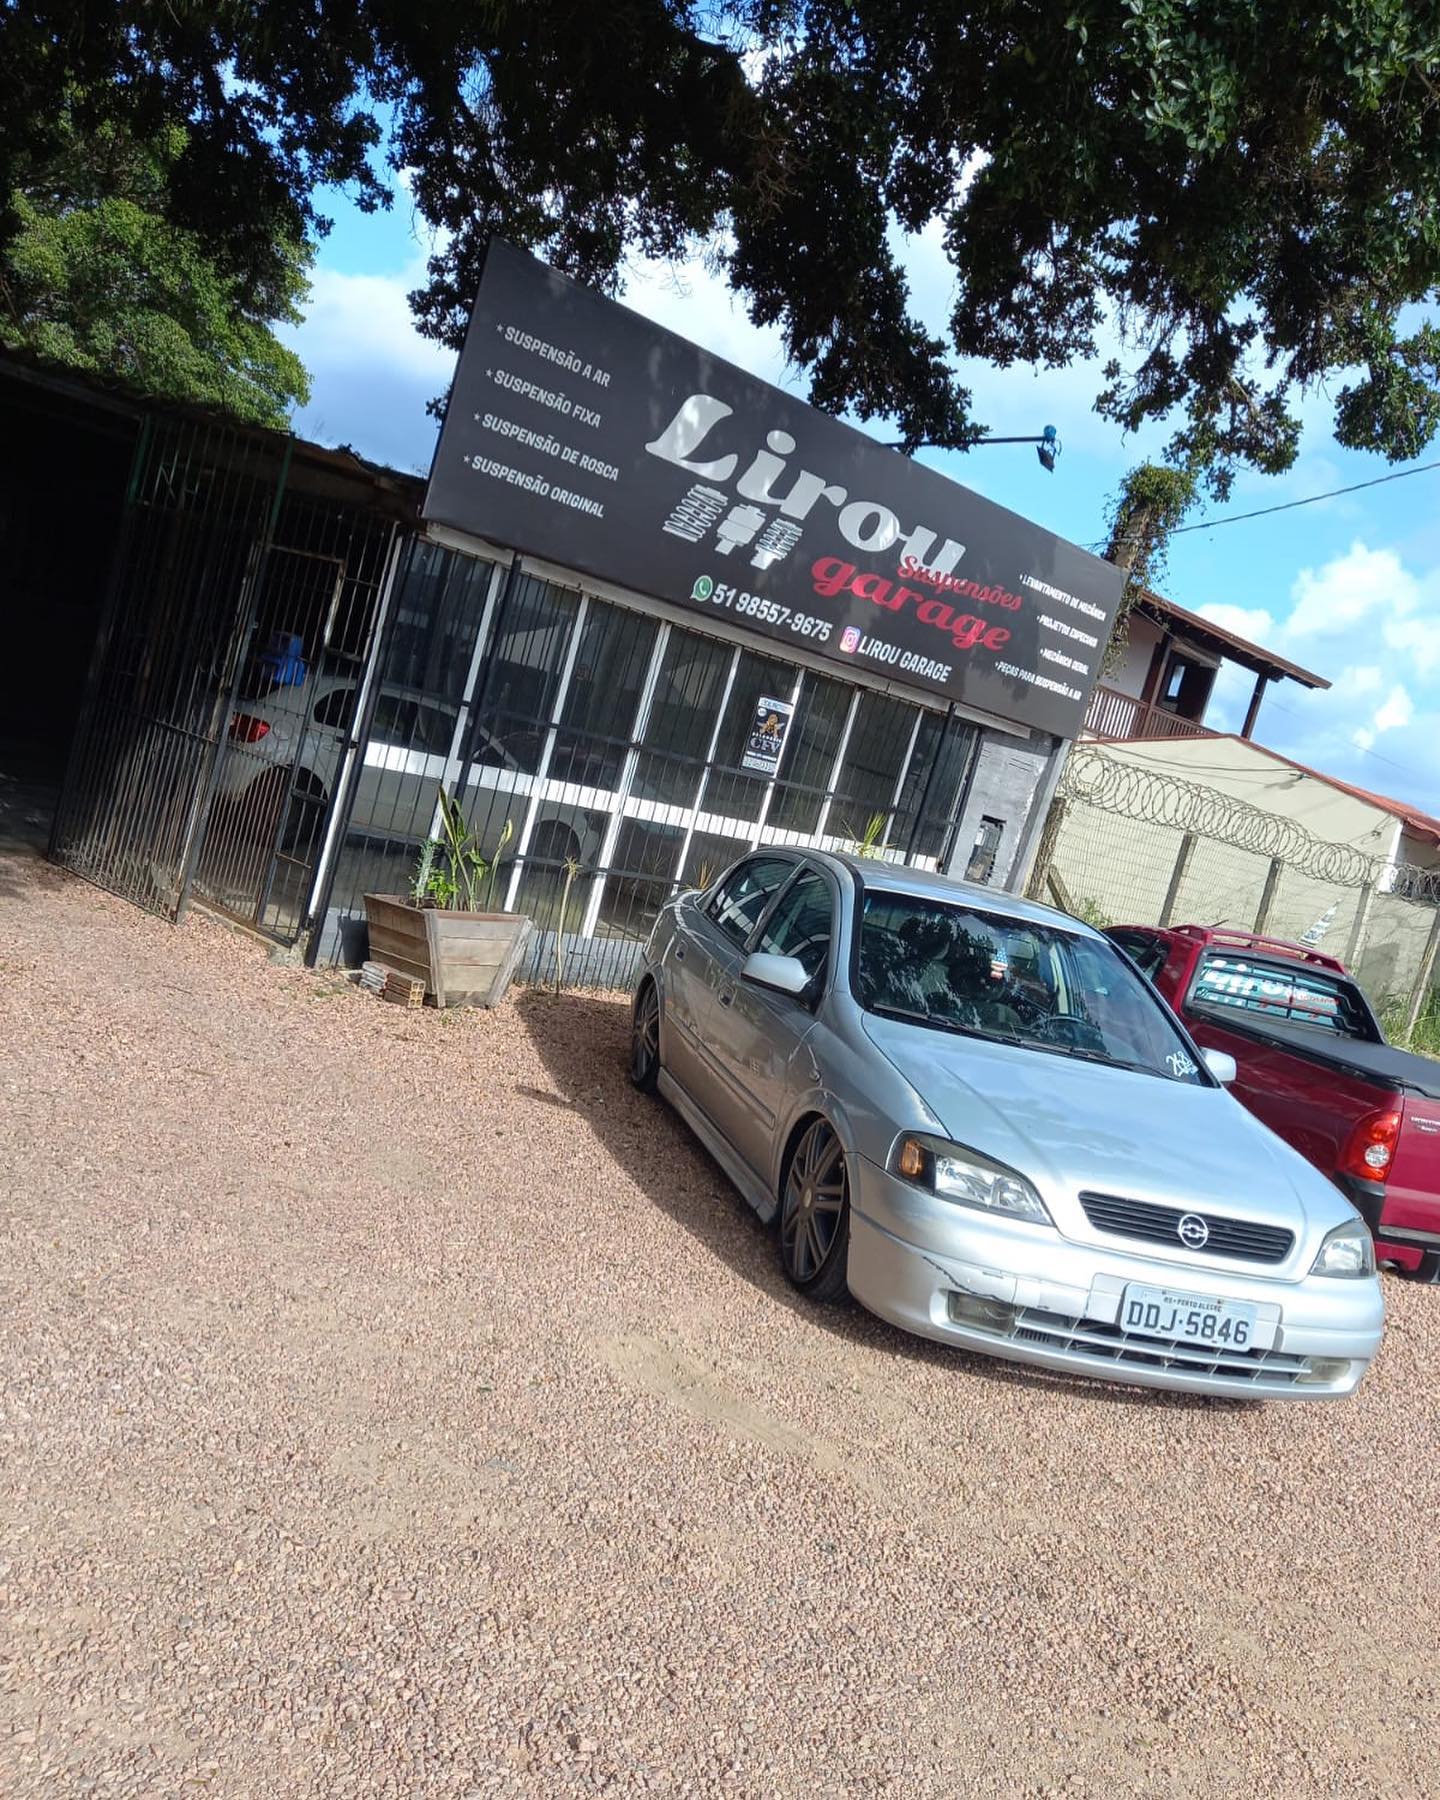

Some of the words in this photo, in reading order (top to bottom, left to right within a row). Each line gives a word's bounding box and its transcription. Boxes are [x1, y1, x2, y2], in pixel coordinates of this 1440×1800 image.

[504, 326, 582, 373] SUSPENSÃO
[581, 364, 592, 379] A
[592, 369, 611, 387] AR
[494, 370, 571, 414] SUSPENSÃO
[572, 405, 601, 428] FIXA
[482, 413, 560, 457] SUSPENSÃO
[560, 446, 580, 464] DE
[579, 455, 619, 482] ROSCA
[471, 455, 550, 496] SUSPENSÃO
[550, 487, 605, 518] ORIGINAL
[645, 394, 966, 578] Lirou
[712, 583, 737, 607] 51
[735, 592, 833, 641] 98557-9675
[811, 556, 1012, 650] garage
[898, 555, 1024, 611] Suspensões
[1022, 574, 1071, 605] LEVANTAMENTO
[857, 635, 901, 665] LIROU
[899, 653, 952, 682] GARAGE
[997, 661, 1019, 676] PEÇAS
[1018, 669, 1036, 683] PARA
